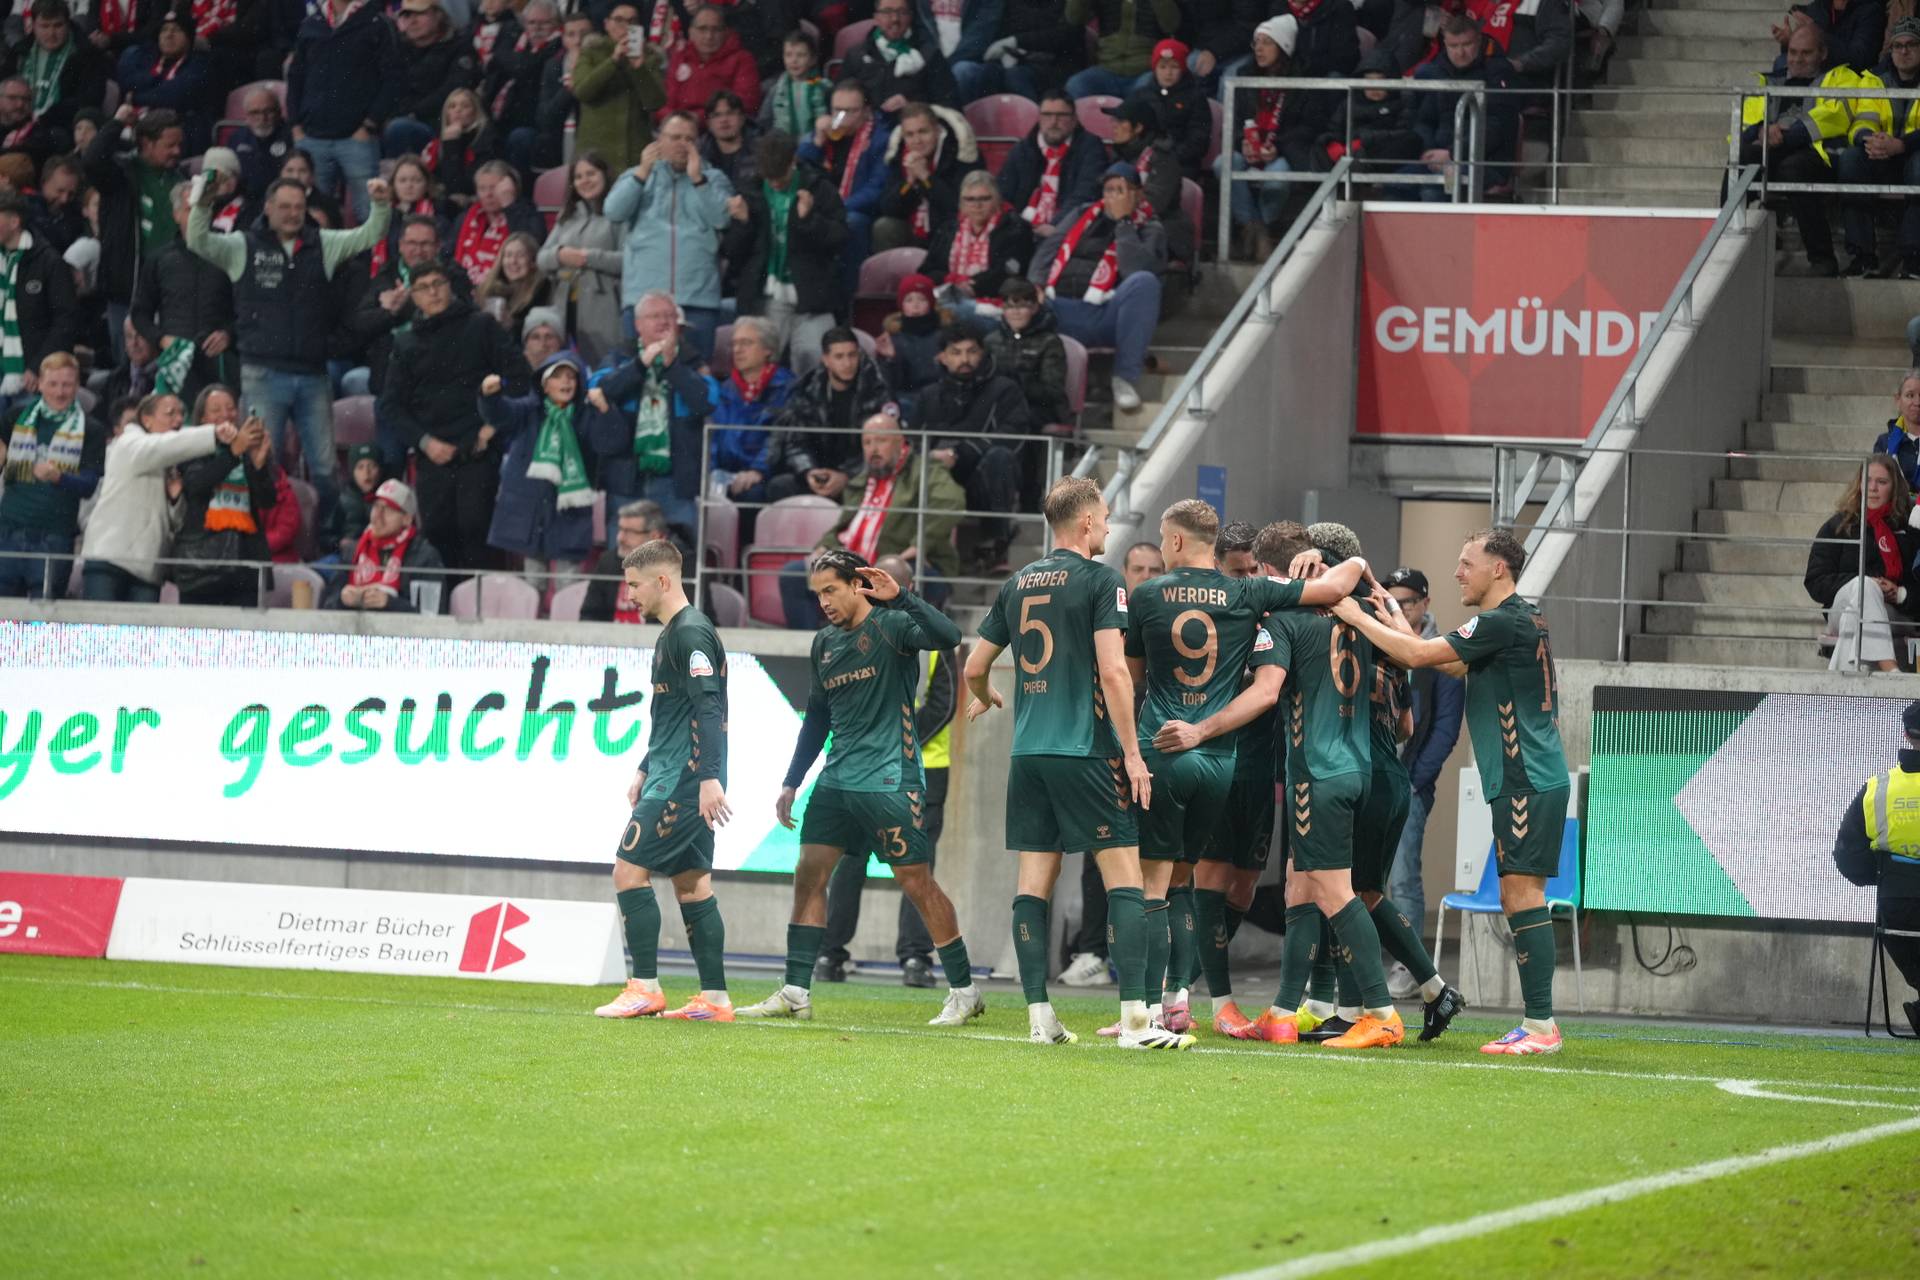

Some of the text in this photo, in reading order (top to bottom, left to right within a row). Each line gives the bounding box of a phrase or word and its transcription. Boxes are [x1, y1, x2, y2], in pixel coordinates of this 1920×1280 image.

[1016, 570, 1069, 591] WERDER
[1162, 586, 1227, 607] WERDER
[1019, 594, 1054, 675] 5
[1171, 609, 1219, 687] 9
[1330, 622, 1361, 698] 6
[1182, 693, 1207, 705] TOPP
[219, 654, 645, 799] gesucht
[278, 911, 455, 938] Dietmar Bücher
[179, 931, 450, 964] Schlüsselfertiges Bauen
